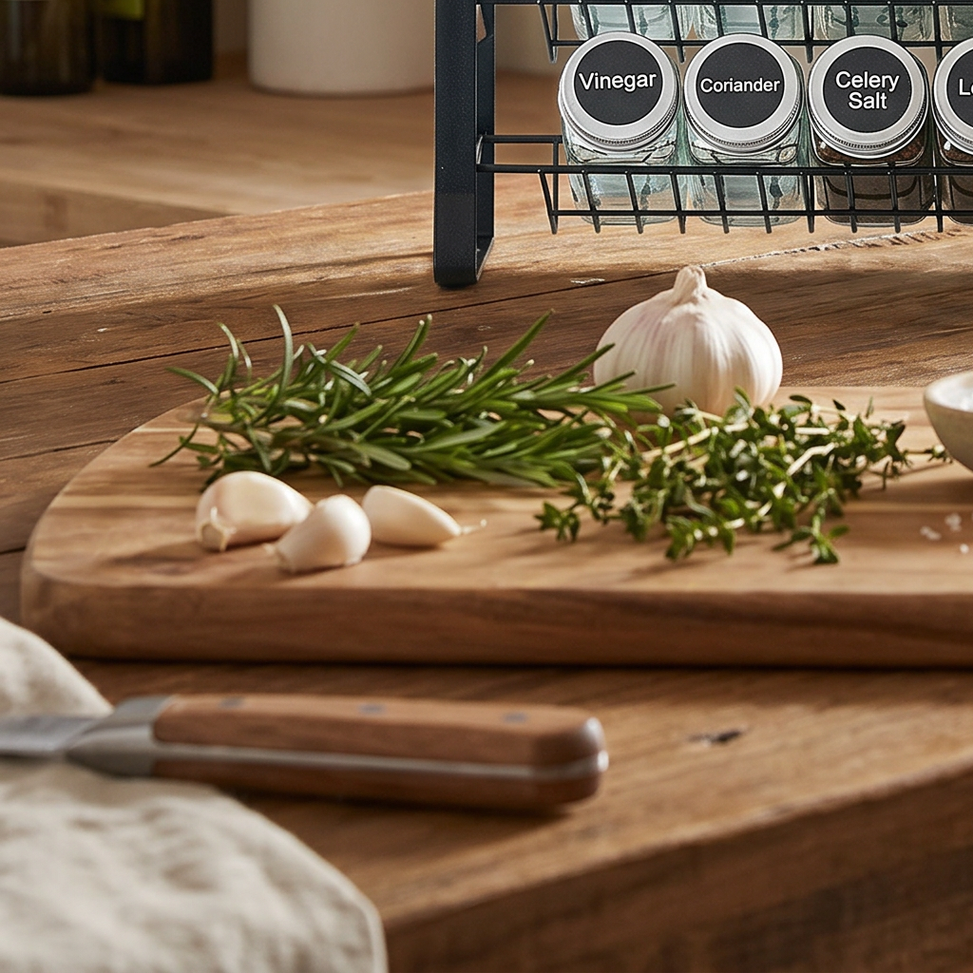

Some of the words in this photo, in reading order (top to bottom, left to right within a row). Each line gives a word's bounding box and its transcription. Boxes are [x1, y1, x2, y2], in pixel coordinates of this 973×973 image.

[578, 72, 657, 93] Vinegar
[700, 77, 781, 93] Coriander
[835, 70, 900, 93] Celery
[848, 91, 888, 110] Salt
